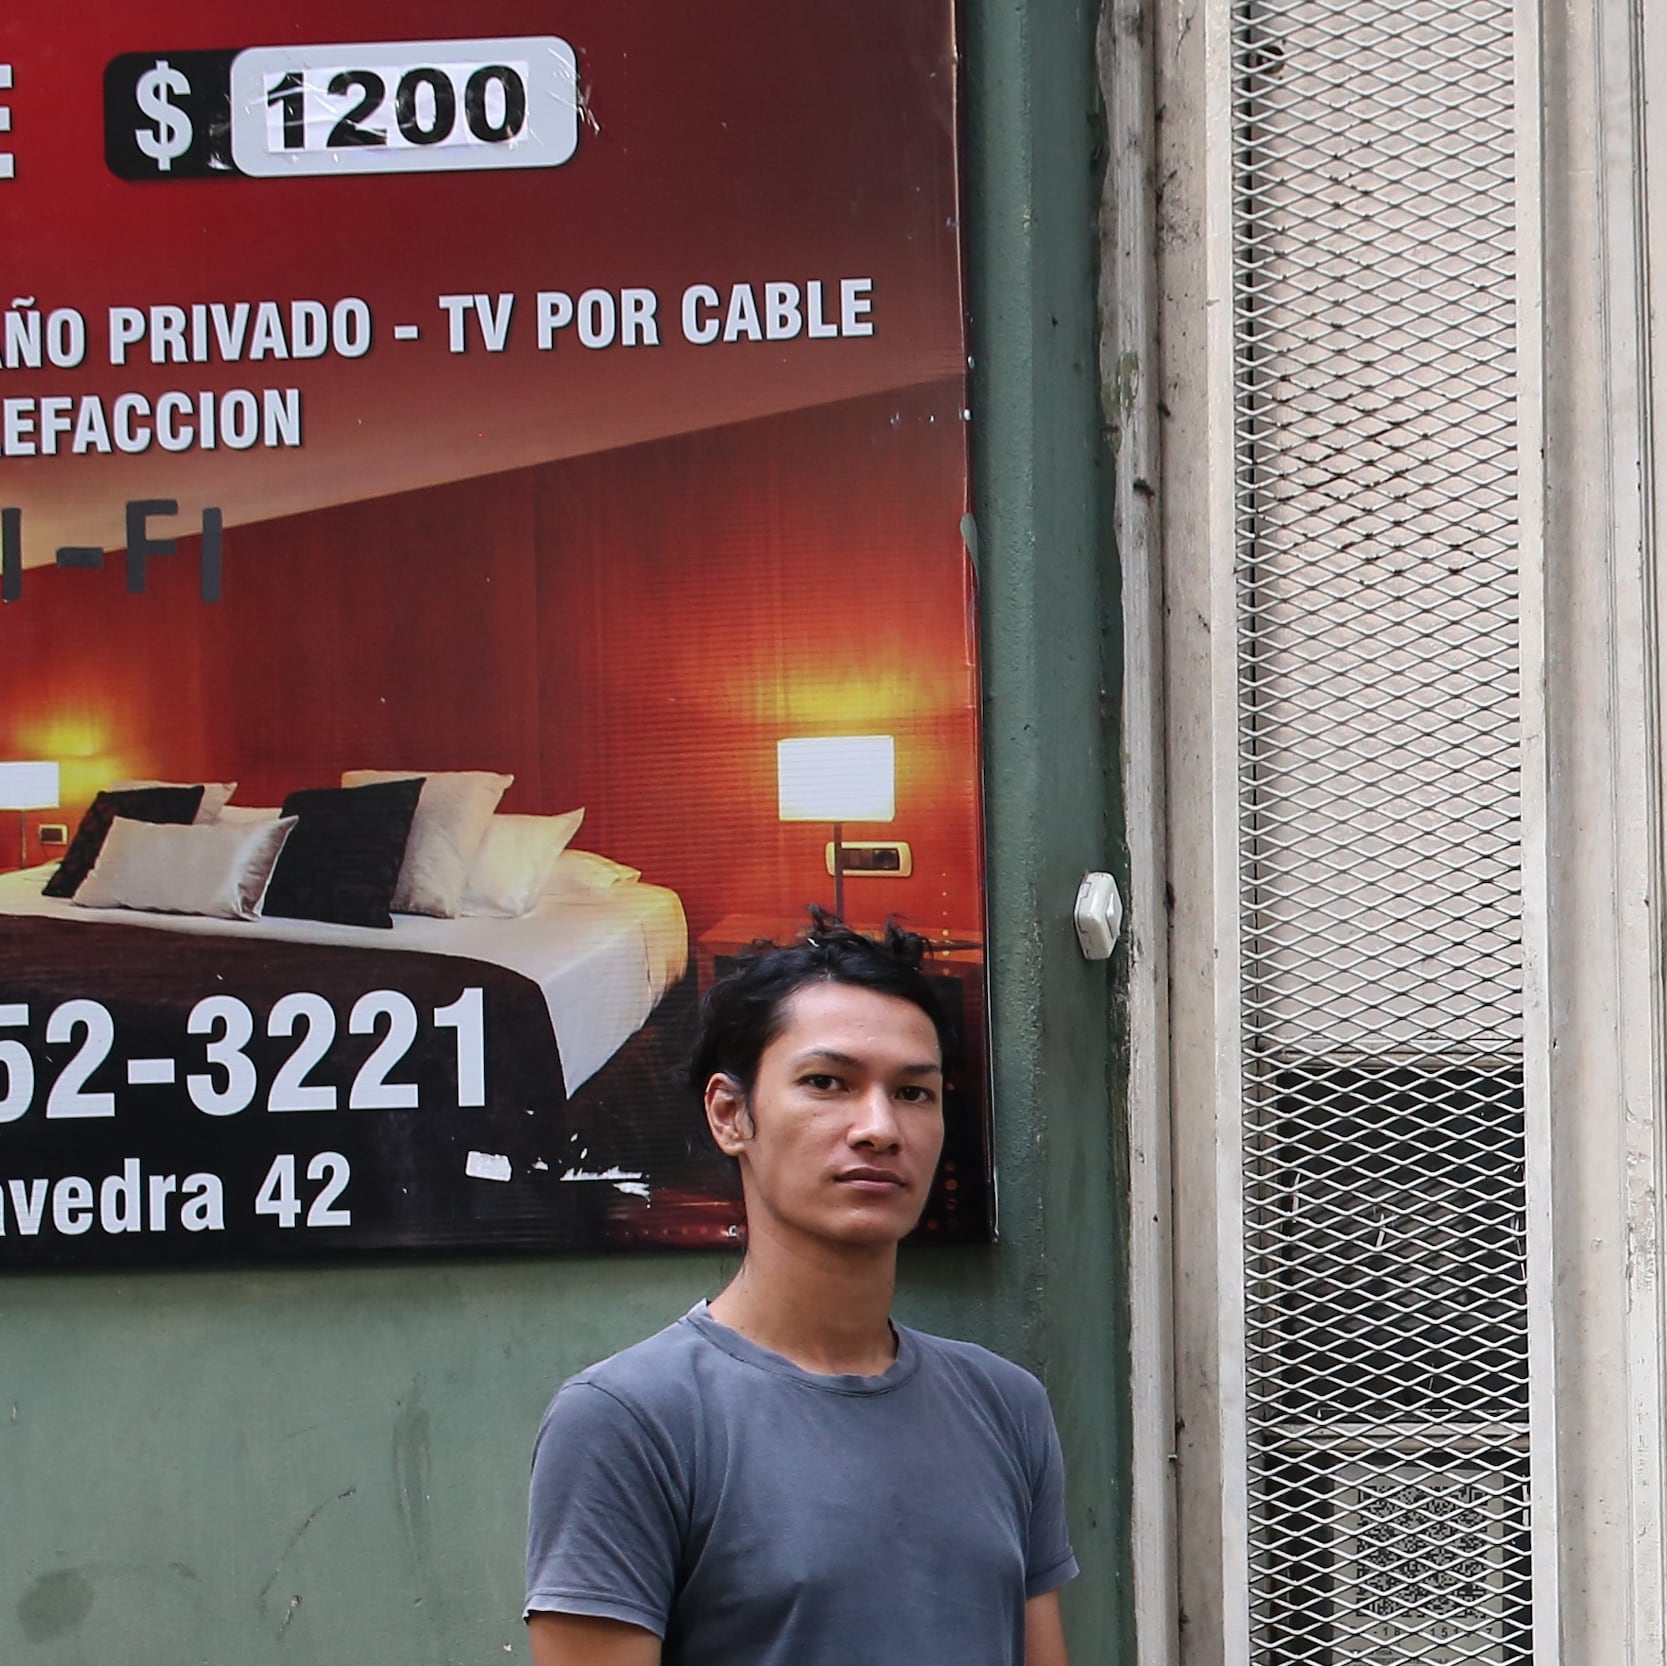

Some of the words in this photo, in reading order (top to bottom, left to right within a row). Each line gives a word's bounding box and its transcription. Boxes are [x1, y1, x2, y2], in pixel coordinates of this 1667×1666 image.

[135, 60, 194, 171] $
[265, 63, 527, 151] 1200
[0, 296, 86, 369] ÑO
[109, 296, 371, 365] PRIVADO
[439, 294, 515, 353] TV
[538, 288, 659, 350] POR
[681, 278, 874, 344] CABLE
[0, 1157, 225, 1236] vedra
[255, 1151, 351, 1228] 42
